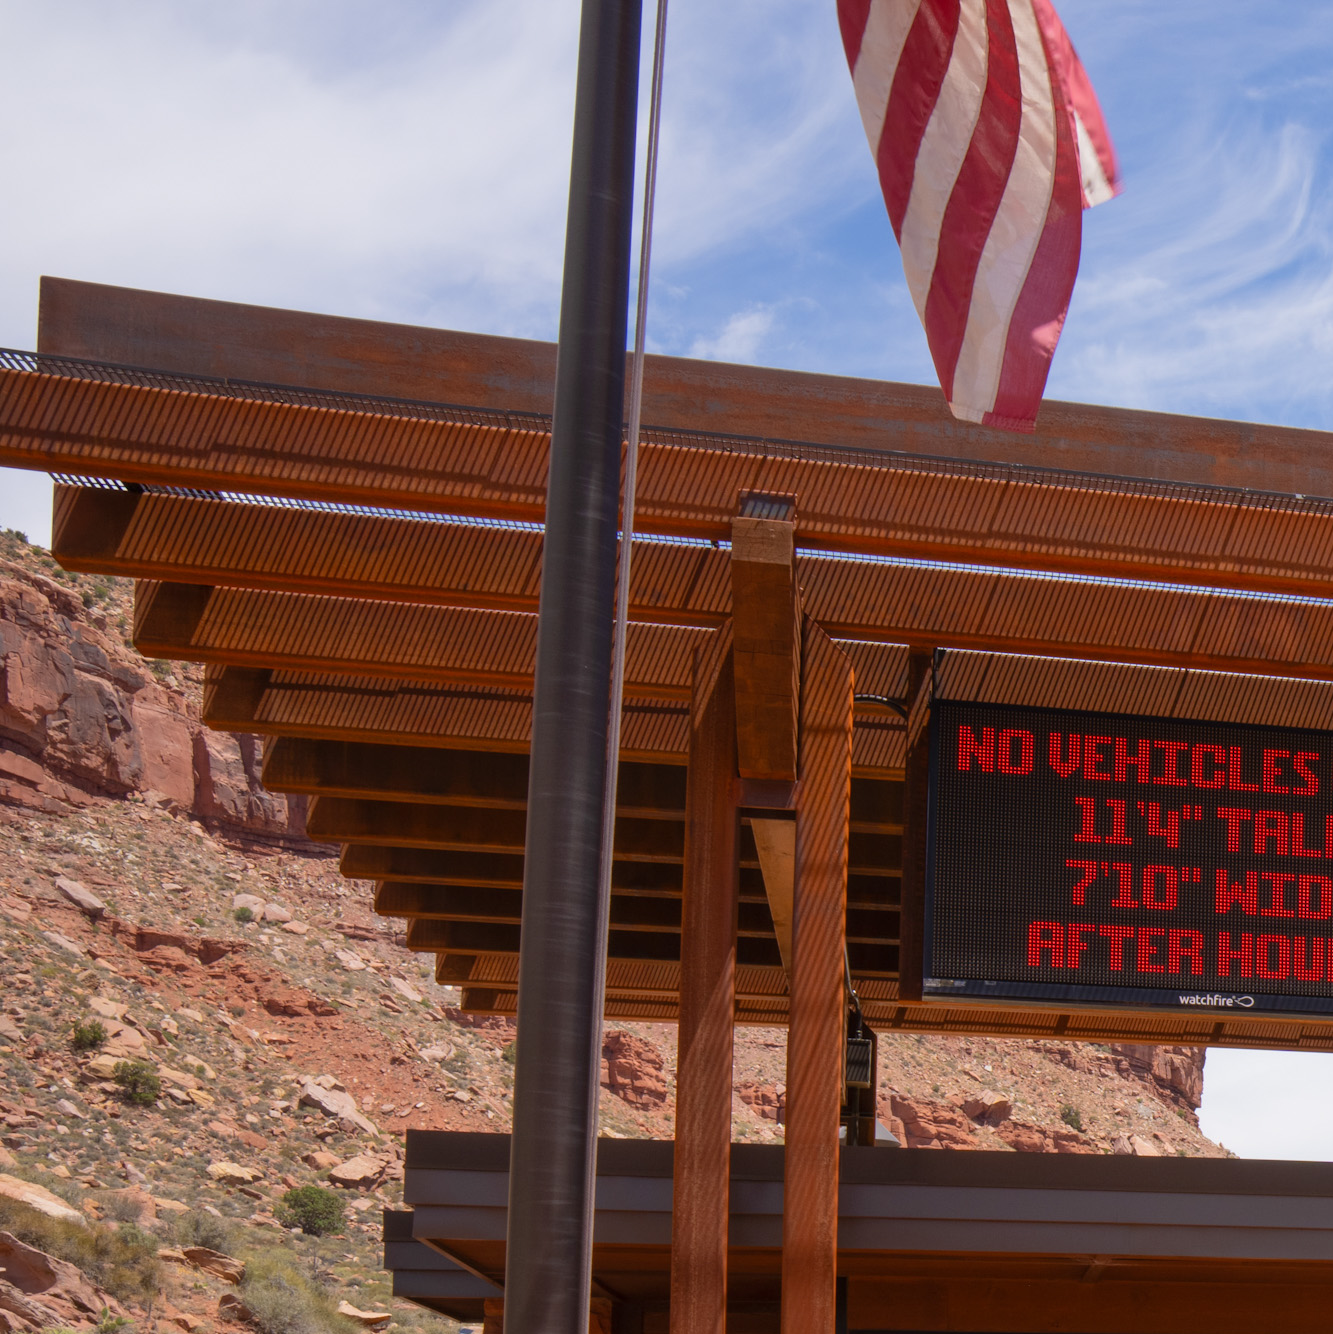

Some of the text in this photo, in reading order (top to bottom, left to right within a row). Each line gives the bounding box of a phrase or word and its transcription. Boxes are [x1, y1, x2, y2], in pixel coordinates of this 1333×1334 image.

[957, 725, 1034, 775] NO
[1049, 732, 1320, 797] VEHICLES
[1074, 796, 1203, 848] 11'4"
[1066, 860, 1201, 911] 7'10"
[1027, 920, 1203, 976] AFTER
[1179, 994, 1234, 1007] watchfire
